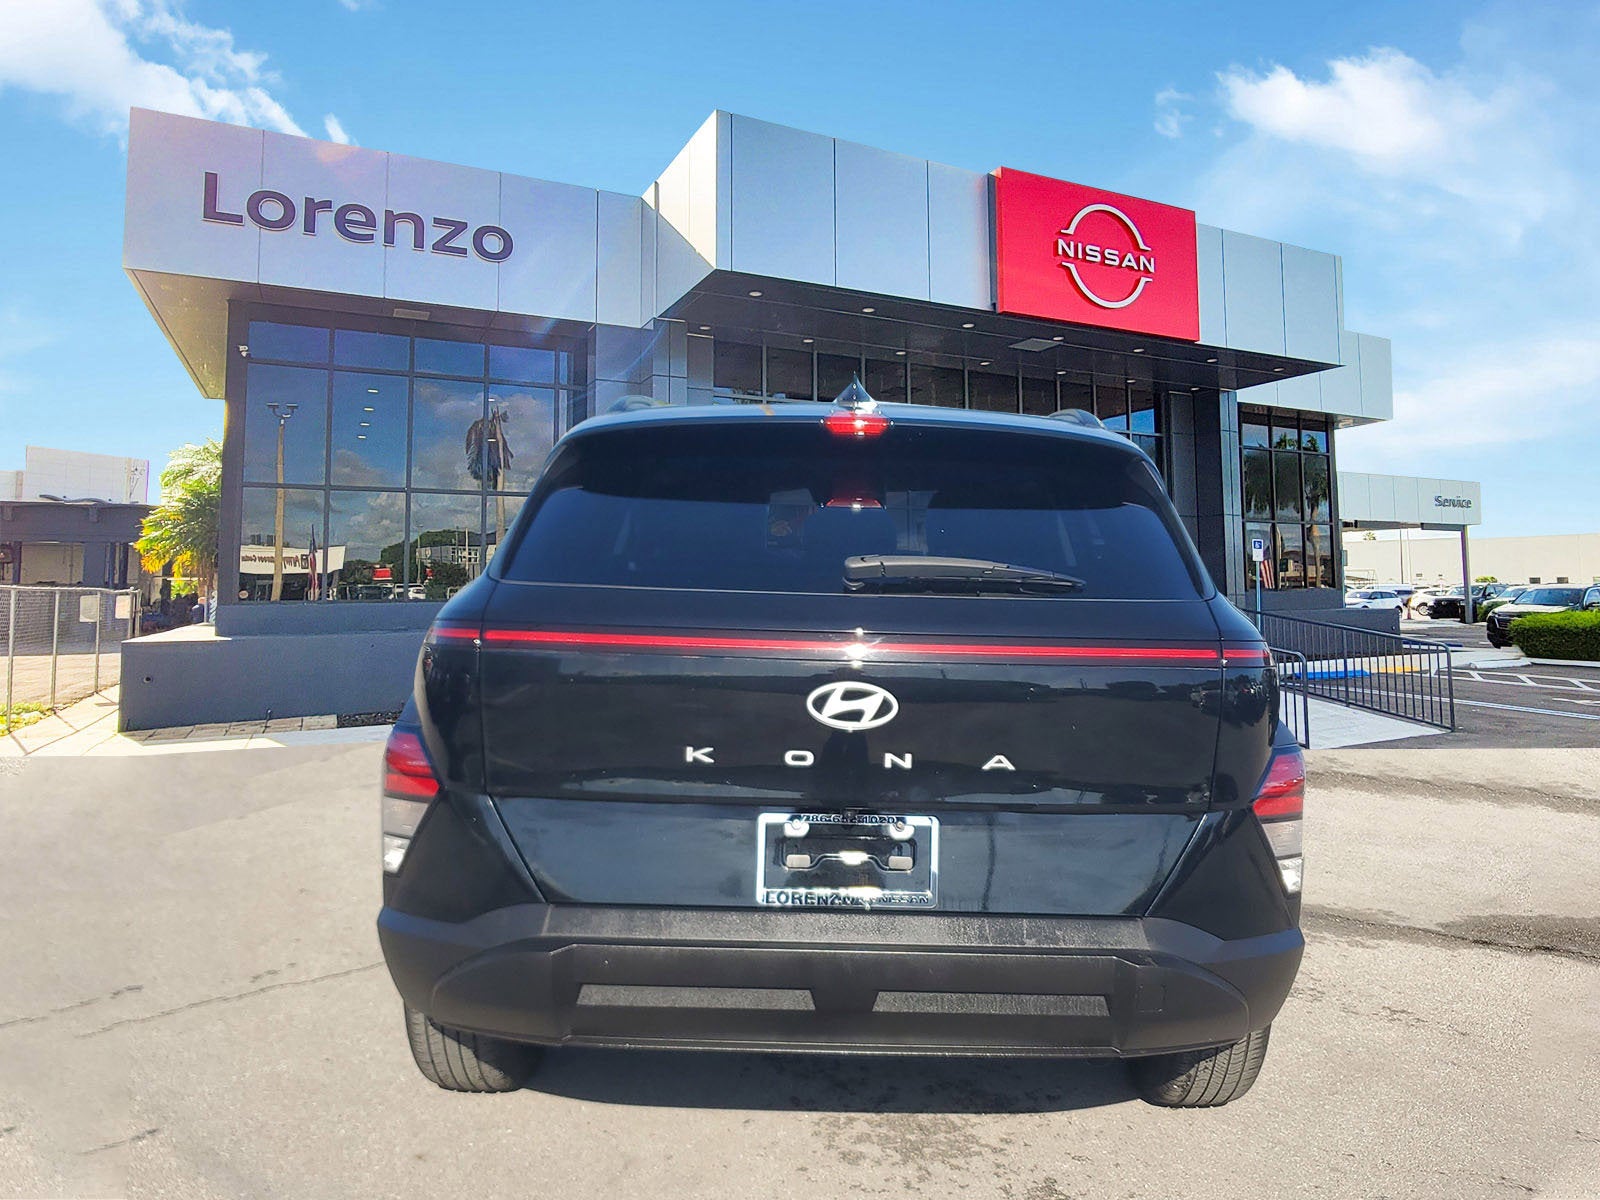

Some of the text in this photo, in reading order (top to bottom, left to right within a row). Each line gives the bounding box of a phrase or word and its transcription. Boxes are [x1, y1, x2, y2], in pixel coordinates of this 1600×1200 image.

[203, 171, 514, 262] Lorenzo
[1057, 238, 1155, 273] NISSAN
[1434, 495, 1472, 509] Service
[686, 746, 1016, 771] KONA
